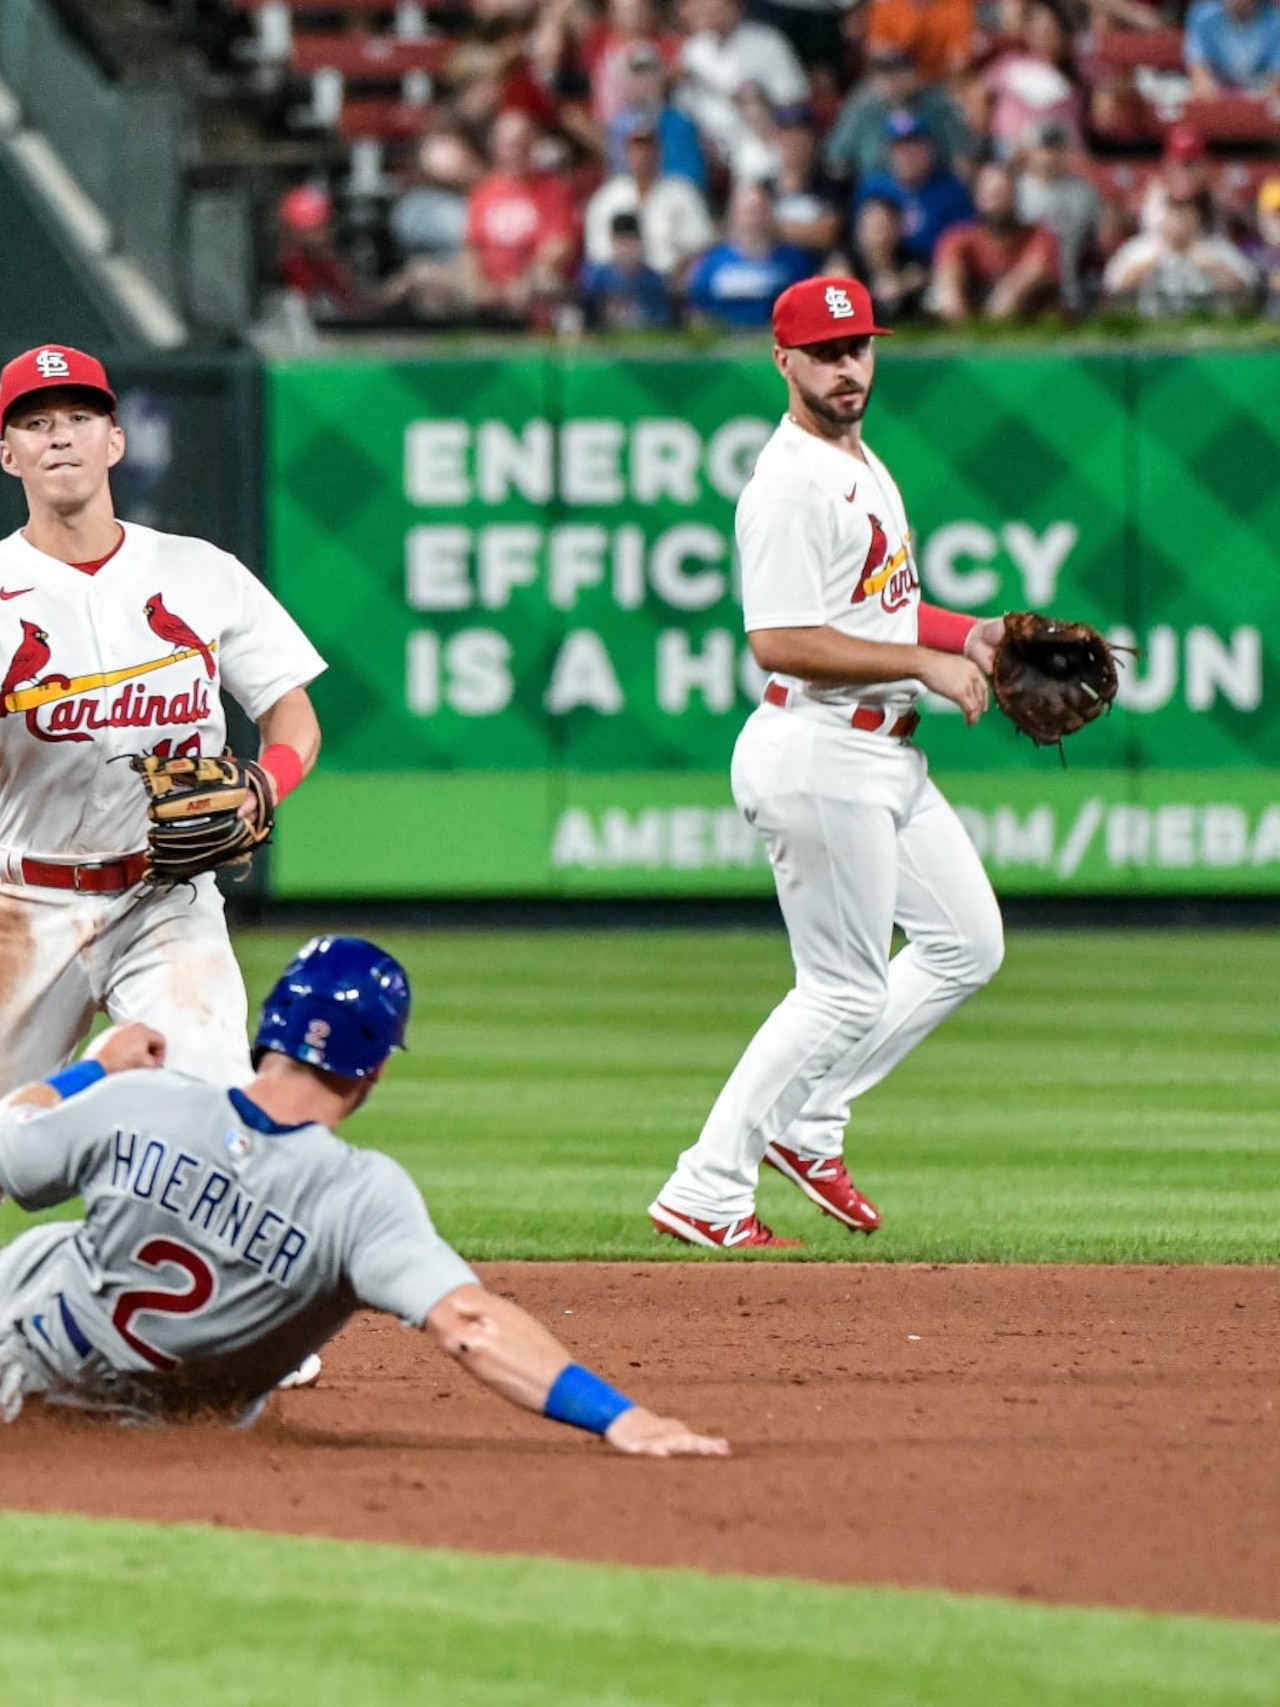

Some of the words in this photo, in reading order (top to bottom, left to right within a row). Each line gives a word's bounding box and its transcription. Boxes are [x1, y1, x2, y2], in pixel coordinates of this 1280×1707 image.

[405, 418, 783, 506] ENERG
[405, 521, 1078, 610] EFFICCY
[25, 673, 211, 743] Cardinals
[406, 627, 513, 716] IS
[543, 627, 626, 716] A
[1110, 623, 1263, 714] UN
[112, 1129, 308, 1283] HOERNER
[111, 1239, 214, 1372] 2
